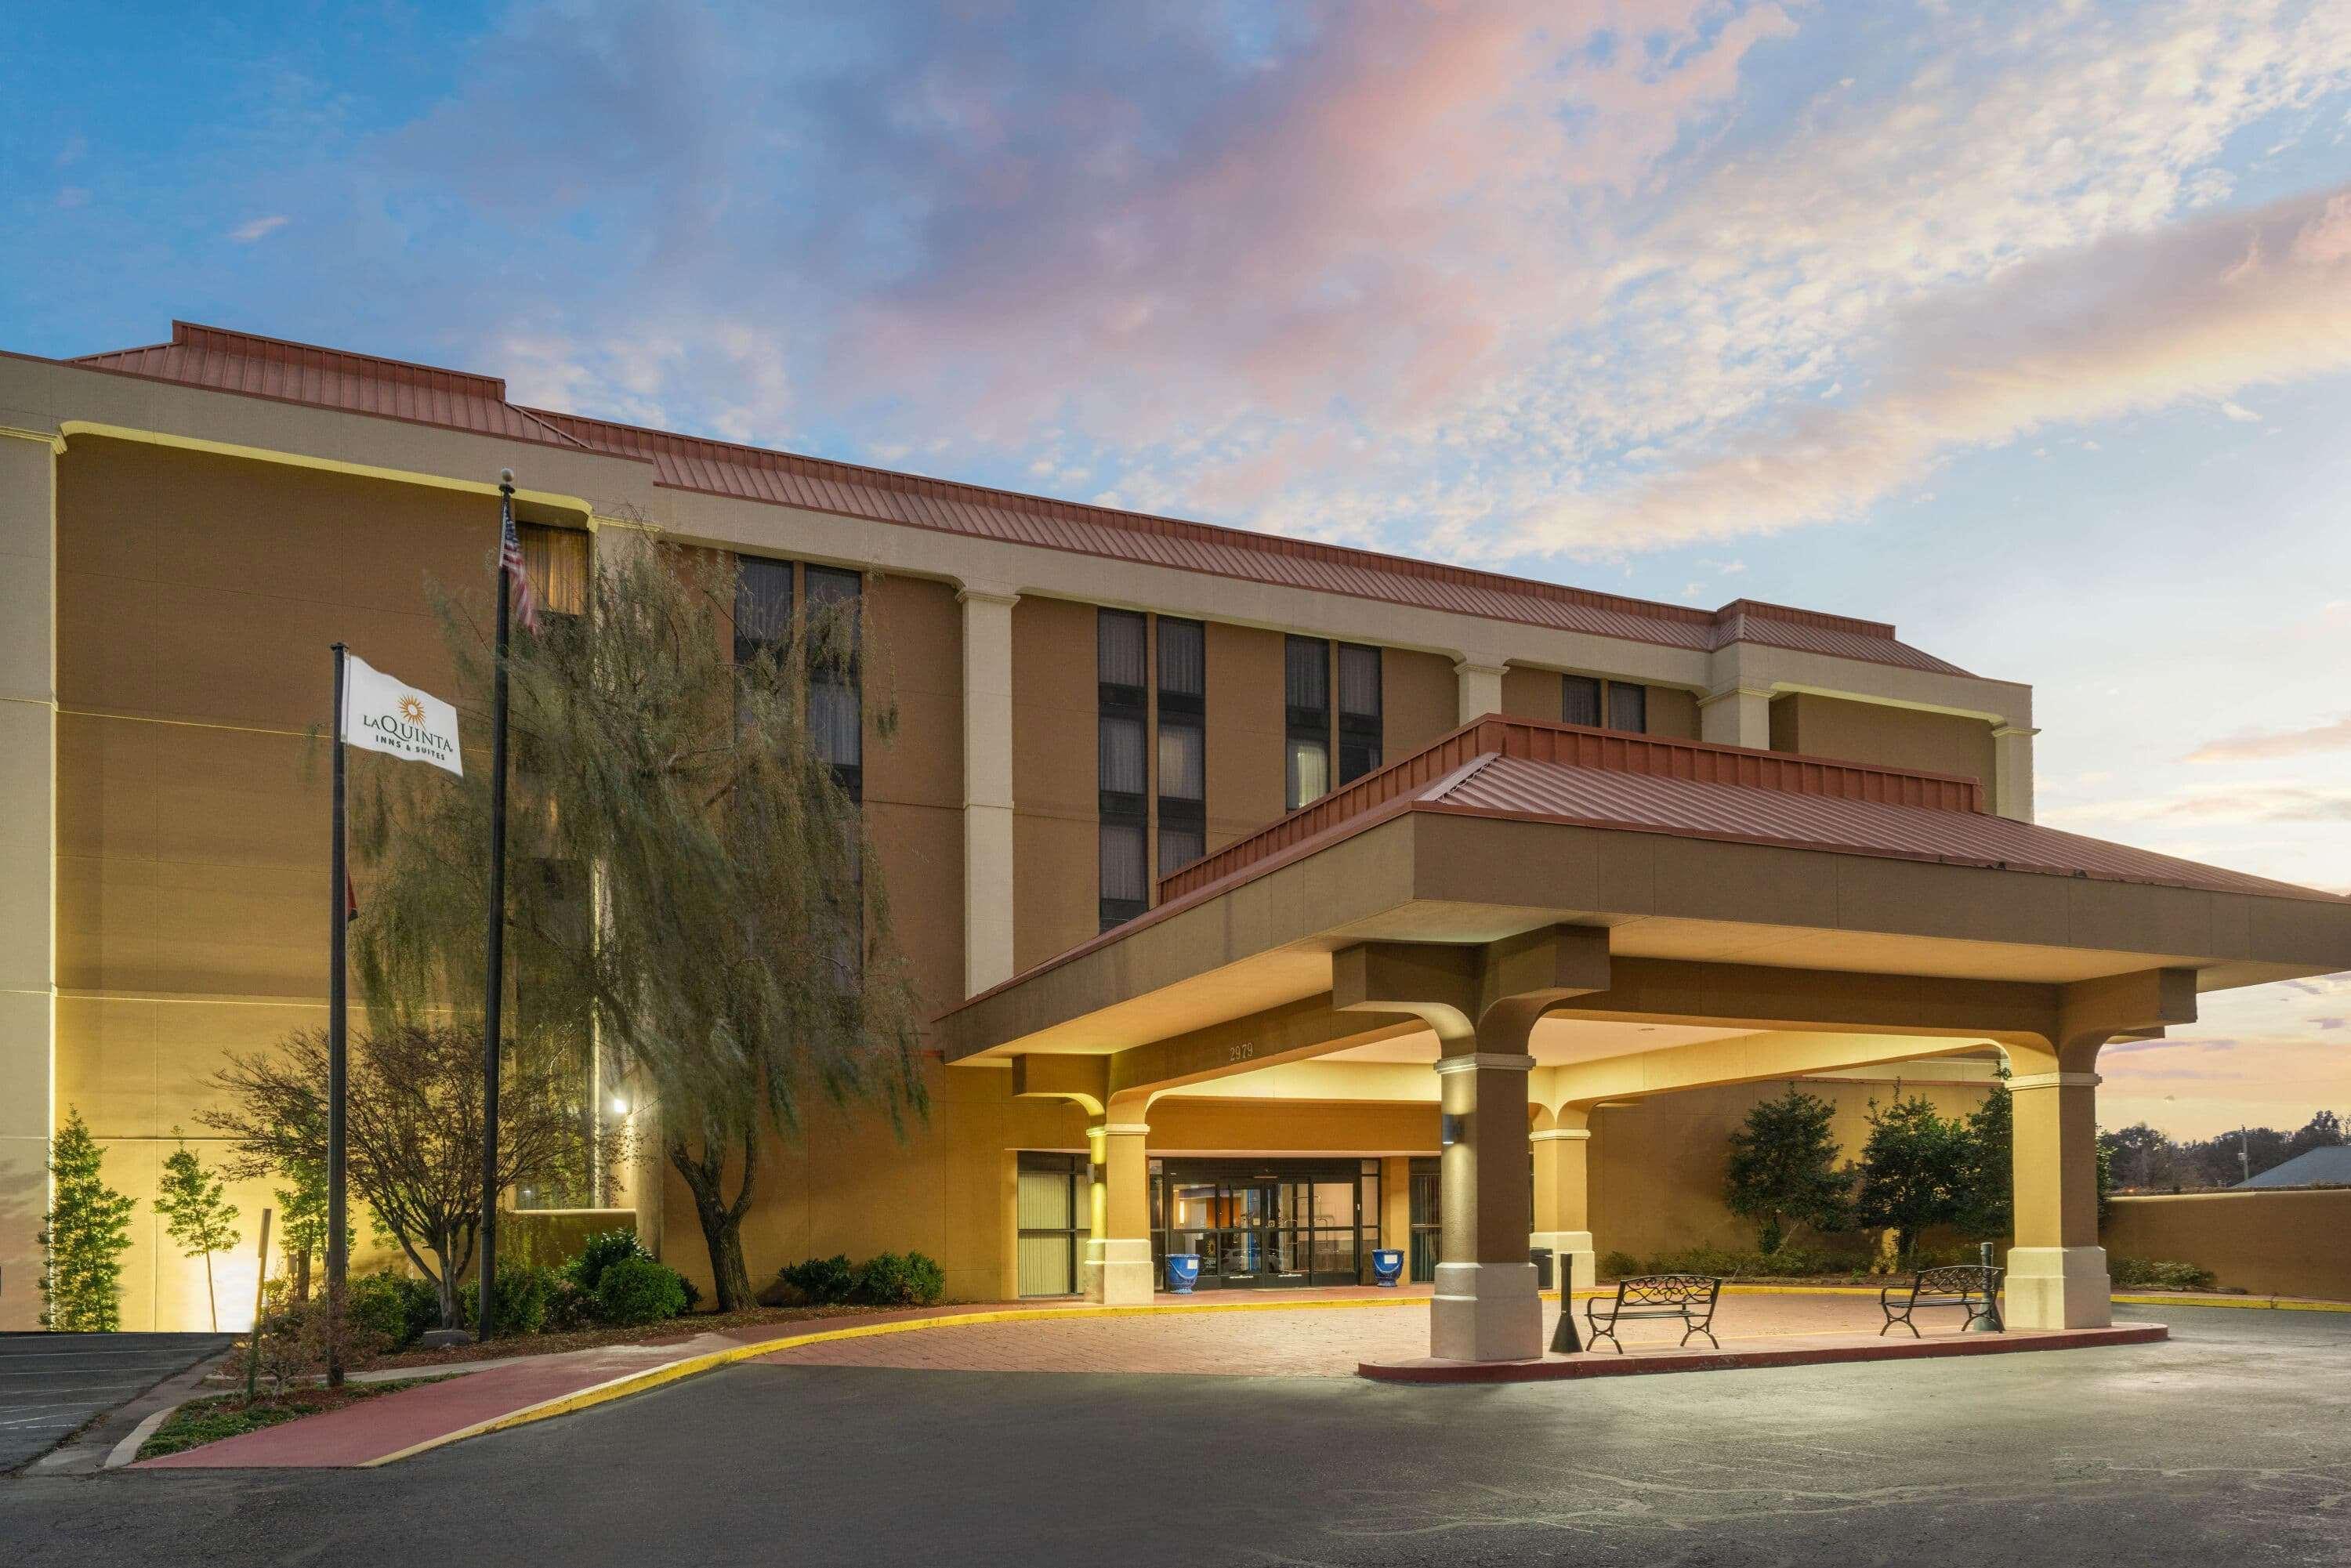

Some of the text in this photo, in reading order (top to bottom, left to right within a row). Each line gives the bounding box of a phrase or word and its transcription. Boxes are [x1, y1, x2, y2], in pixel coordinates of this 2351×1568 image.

[376, 735, 401, 748] INNS
[416, 746, 445, 760] SUITES
[1230, 1042, 1253, 1061] 2979
